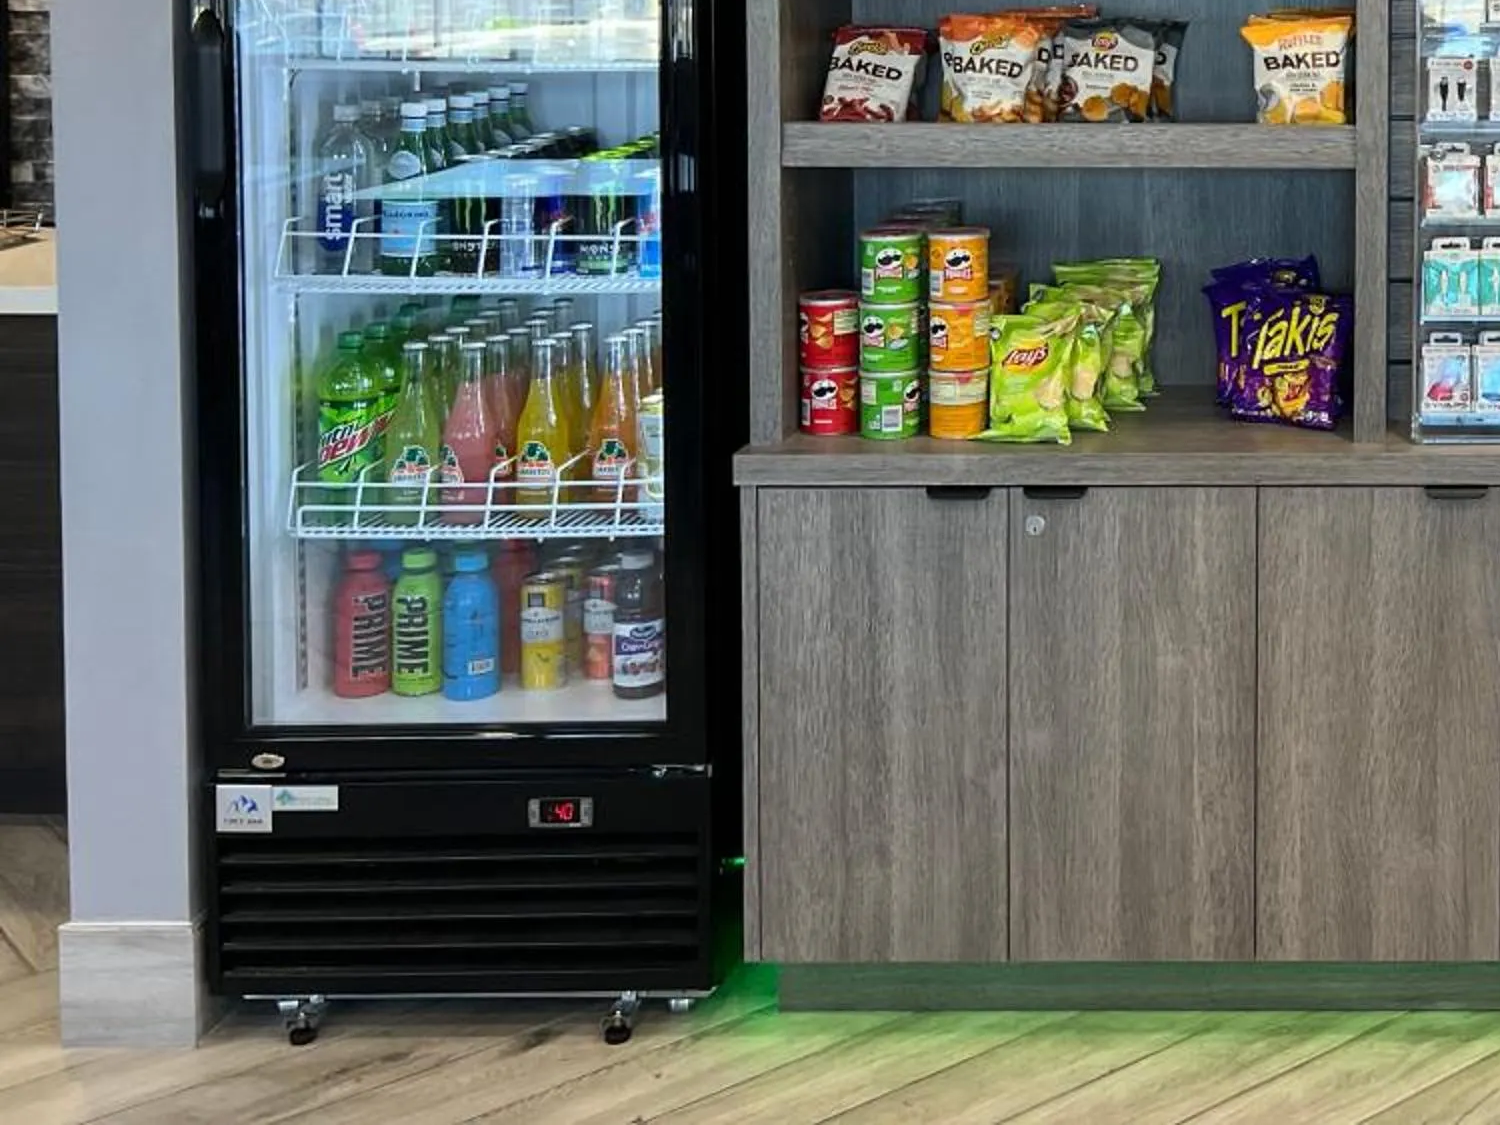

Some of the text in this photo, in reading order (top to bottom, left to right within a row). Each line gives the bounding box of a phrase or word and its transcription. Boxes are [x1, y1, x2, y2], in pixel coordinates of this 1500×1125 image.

[829, 55, 903, 82] BAKED
[953, 55, 1024, 79] BAKED
[1263, 50, 1341, 72] BAKED
[325, 172, 343, 241] smart
[1252, 301, 1340, 371] Takis
[397, 594, 429, 675] PRIME
[555, 802, 574, 820] 40
